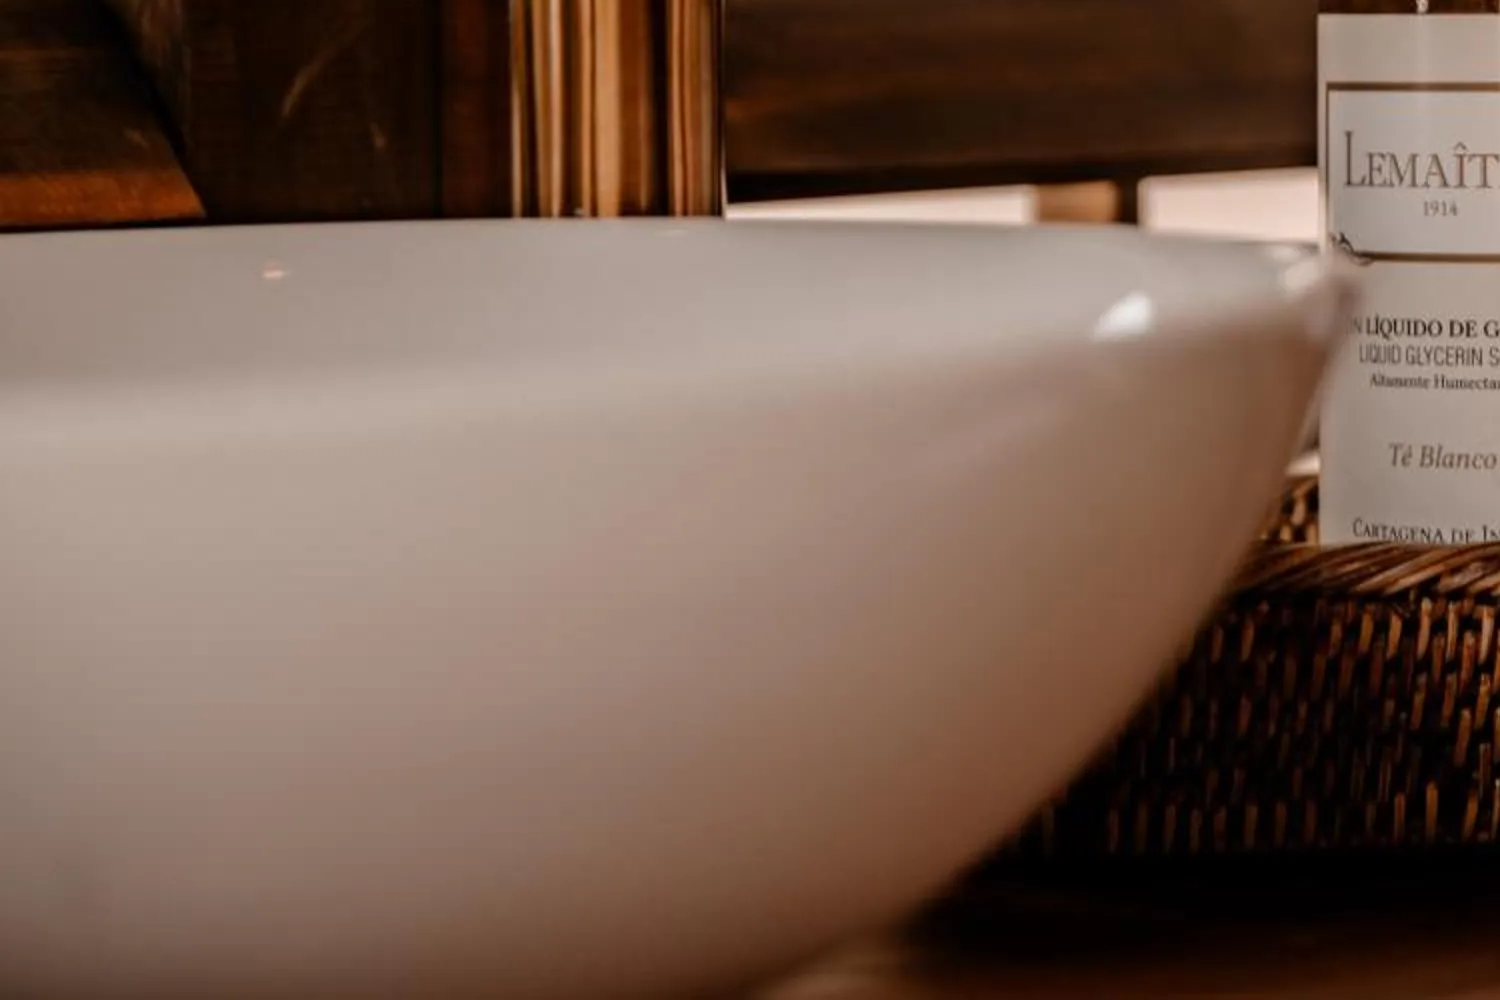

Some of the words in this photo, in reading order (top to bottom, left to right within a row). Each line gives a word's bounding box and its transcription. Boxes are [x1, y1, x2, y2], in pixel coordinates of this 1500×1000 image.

[1423, 200, 1458, 217] 1914
[1450, 319, 1478, 338] DE
[1359, 345, 1402, 366] LIQUID
[1405, 346, 1483, 367] GLYCERIN
[1369, 373, 1430, 389] Altamente
[1389, 442, 1413, 469] Té
[1419, 445, 1498, 471] Blanco
